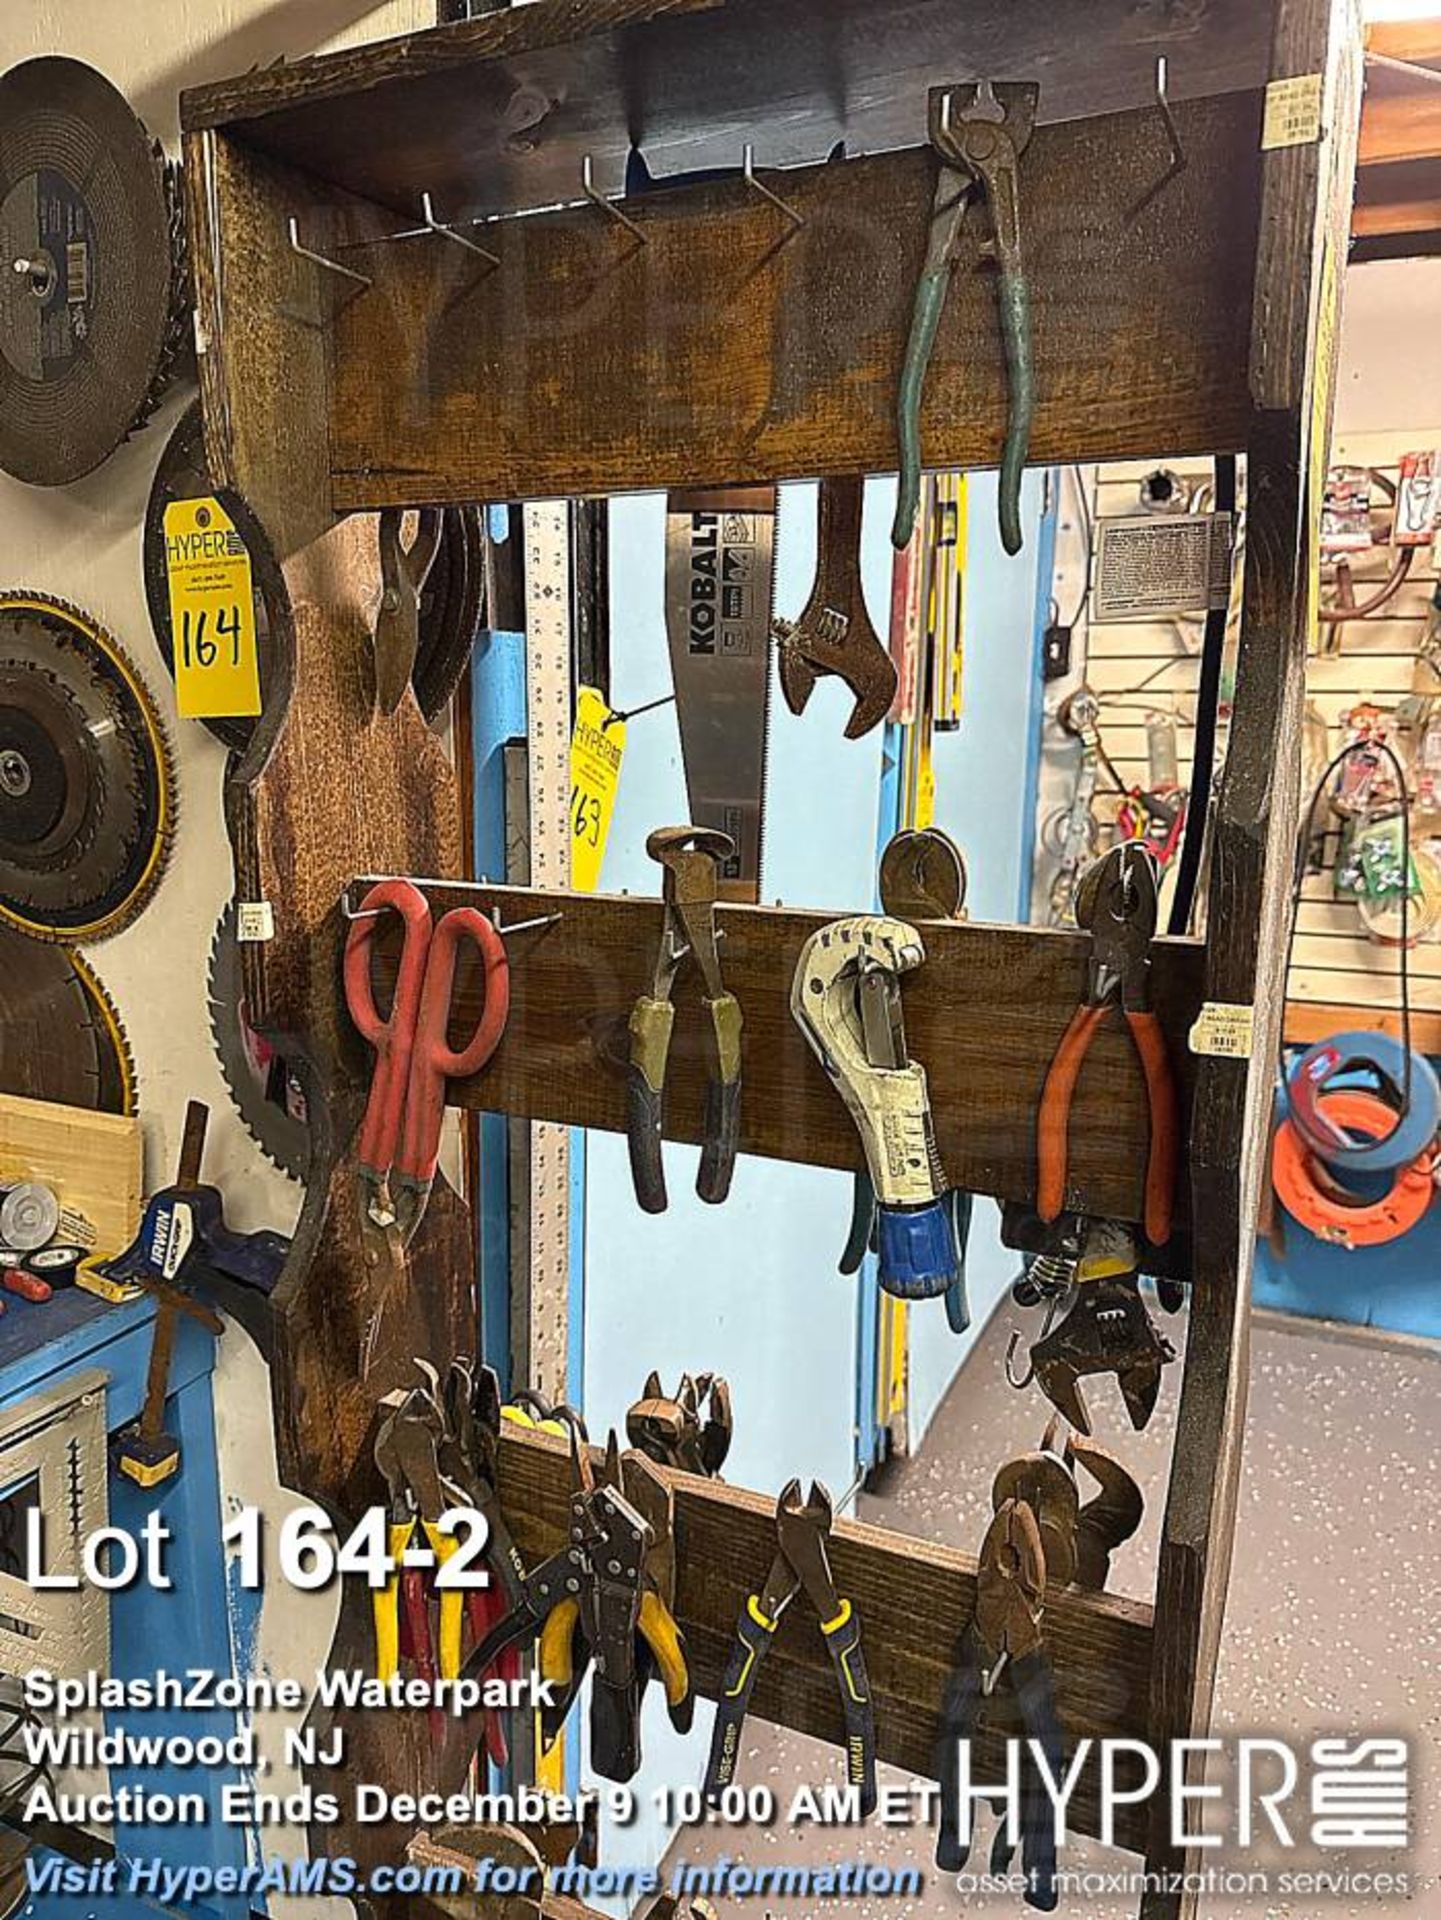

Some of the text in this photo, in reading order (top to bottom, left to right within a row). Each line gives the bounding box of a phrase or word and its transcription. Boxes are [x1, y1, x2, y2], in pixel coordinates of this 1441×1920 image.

[167, 530, 226, 562] HYPER
[689, 512, 718, 655] KOBALT
[183, 605, 241, 667] 164
[150, 1209, 171, 1267] IRWIN
[850, 1736, 866, 1784] IRWIN
